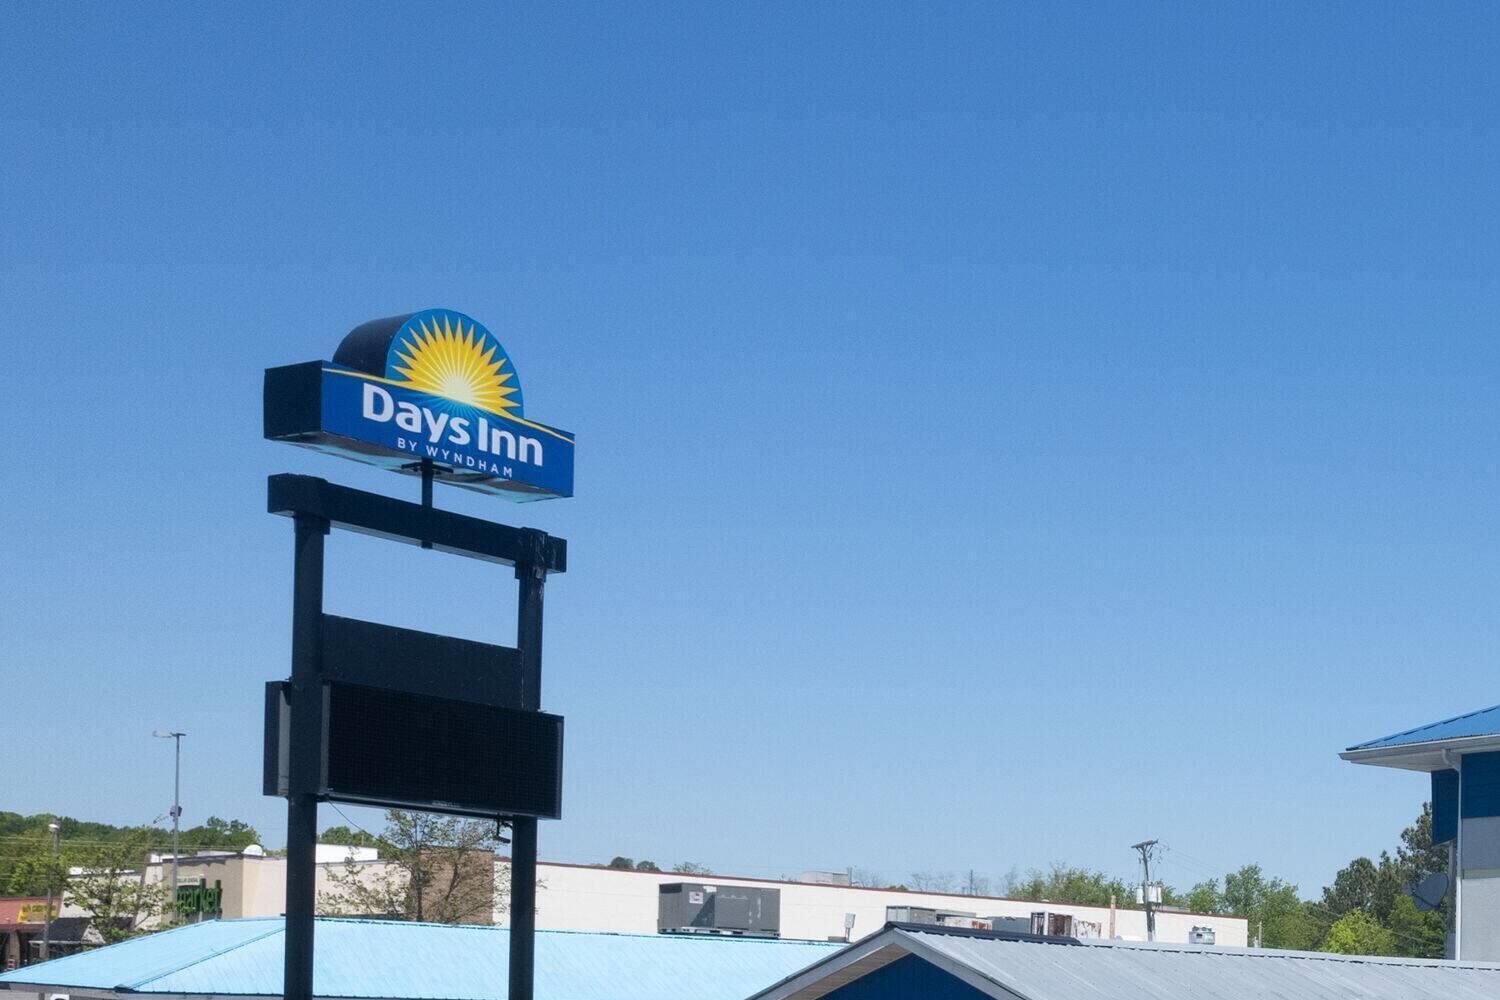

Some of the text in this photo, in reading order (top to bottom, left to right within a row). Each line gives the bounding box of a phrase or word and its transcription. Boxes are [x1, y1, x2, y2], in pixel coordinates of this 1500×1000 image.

[363, 382, 543, 467] Days Inn
[397, 437, 513, 479] BY WYNDHAM
